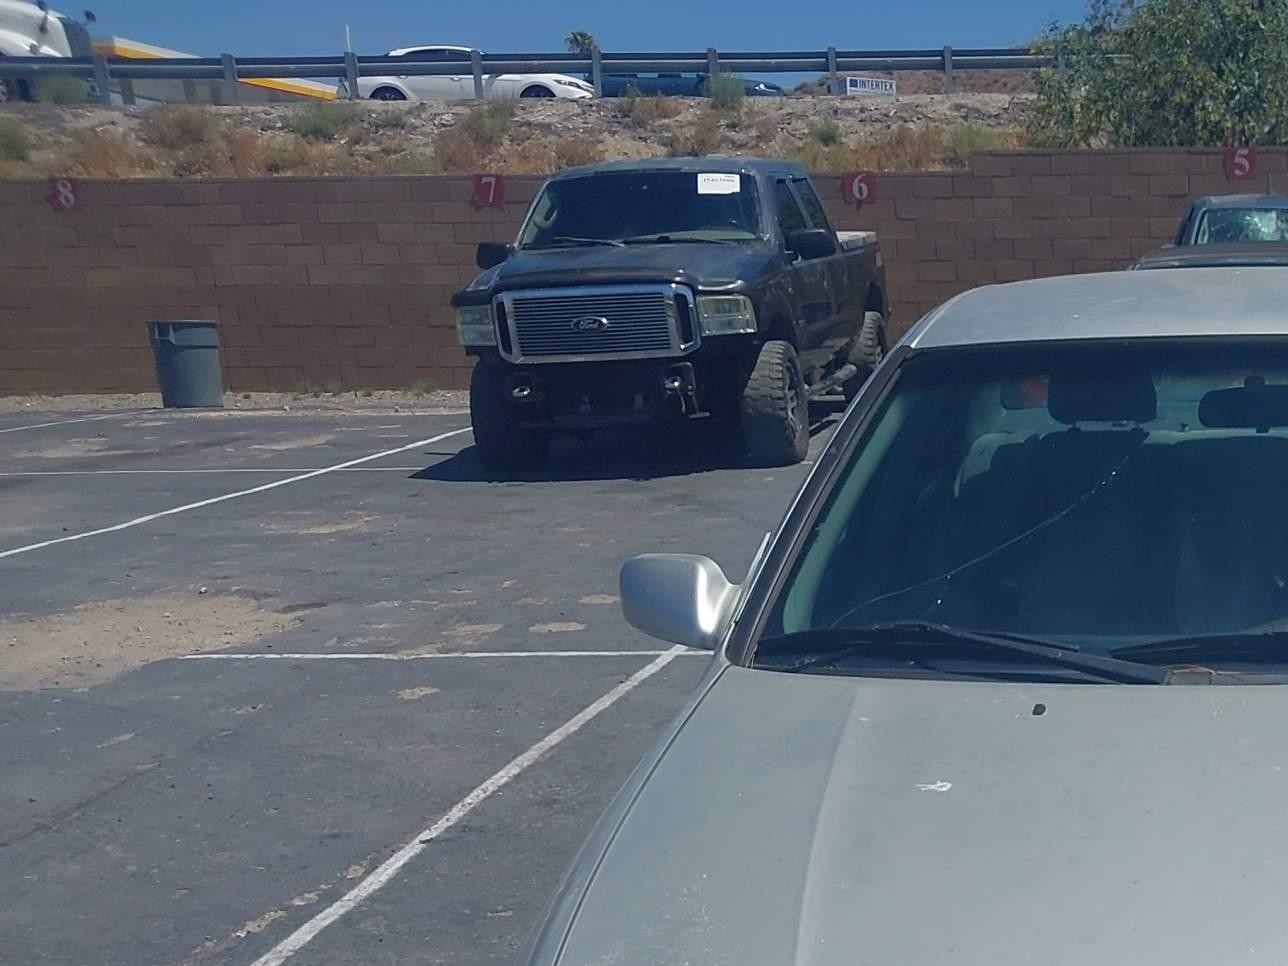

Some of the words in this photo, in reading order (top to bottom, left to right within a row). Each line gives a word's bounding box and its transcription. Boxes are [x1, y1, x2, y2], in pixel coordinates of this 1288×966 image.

[859, 79, 895, 92] INTERTEX
[1234, 150, 1250, 175] 5
[56, 180, 75, 209] 8
[481, 177, 496, 204] 7
[852, 174, 868, 200] 6
